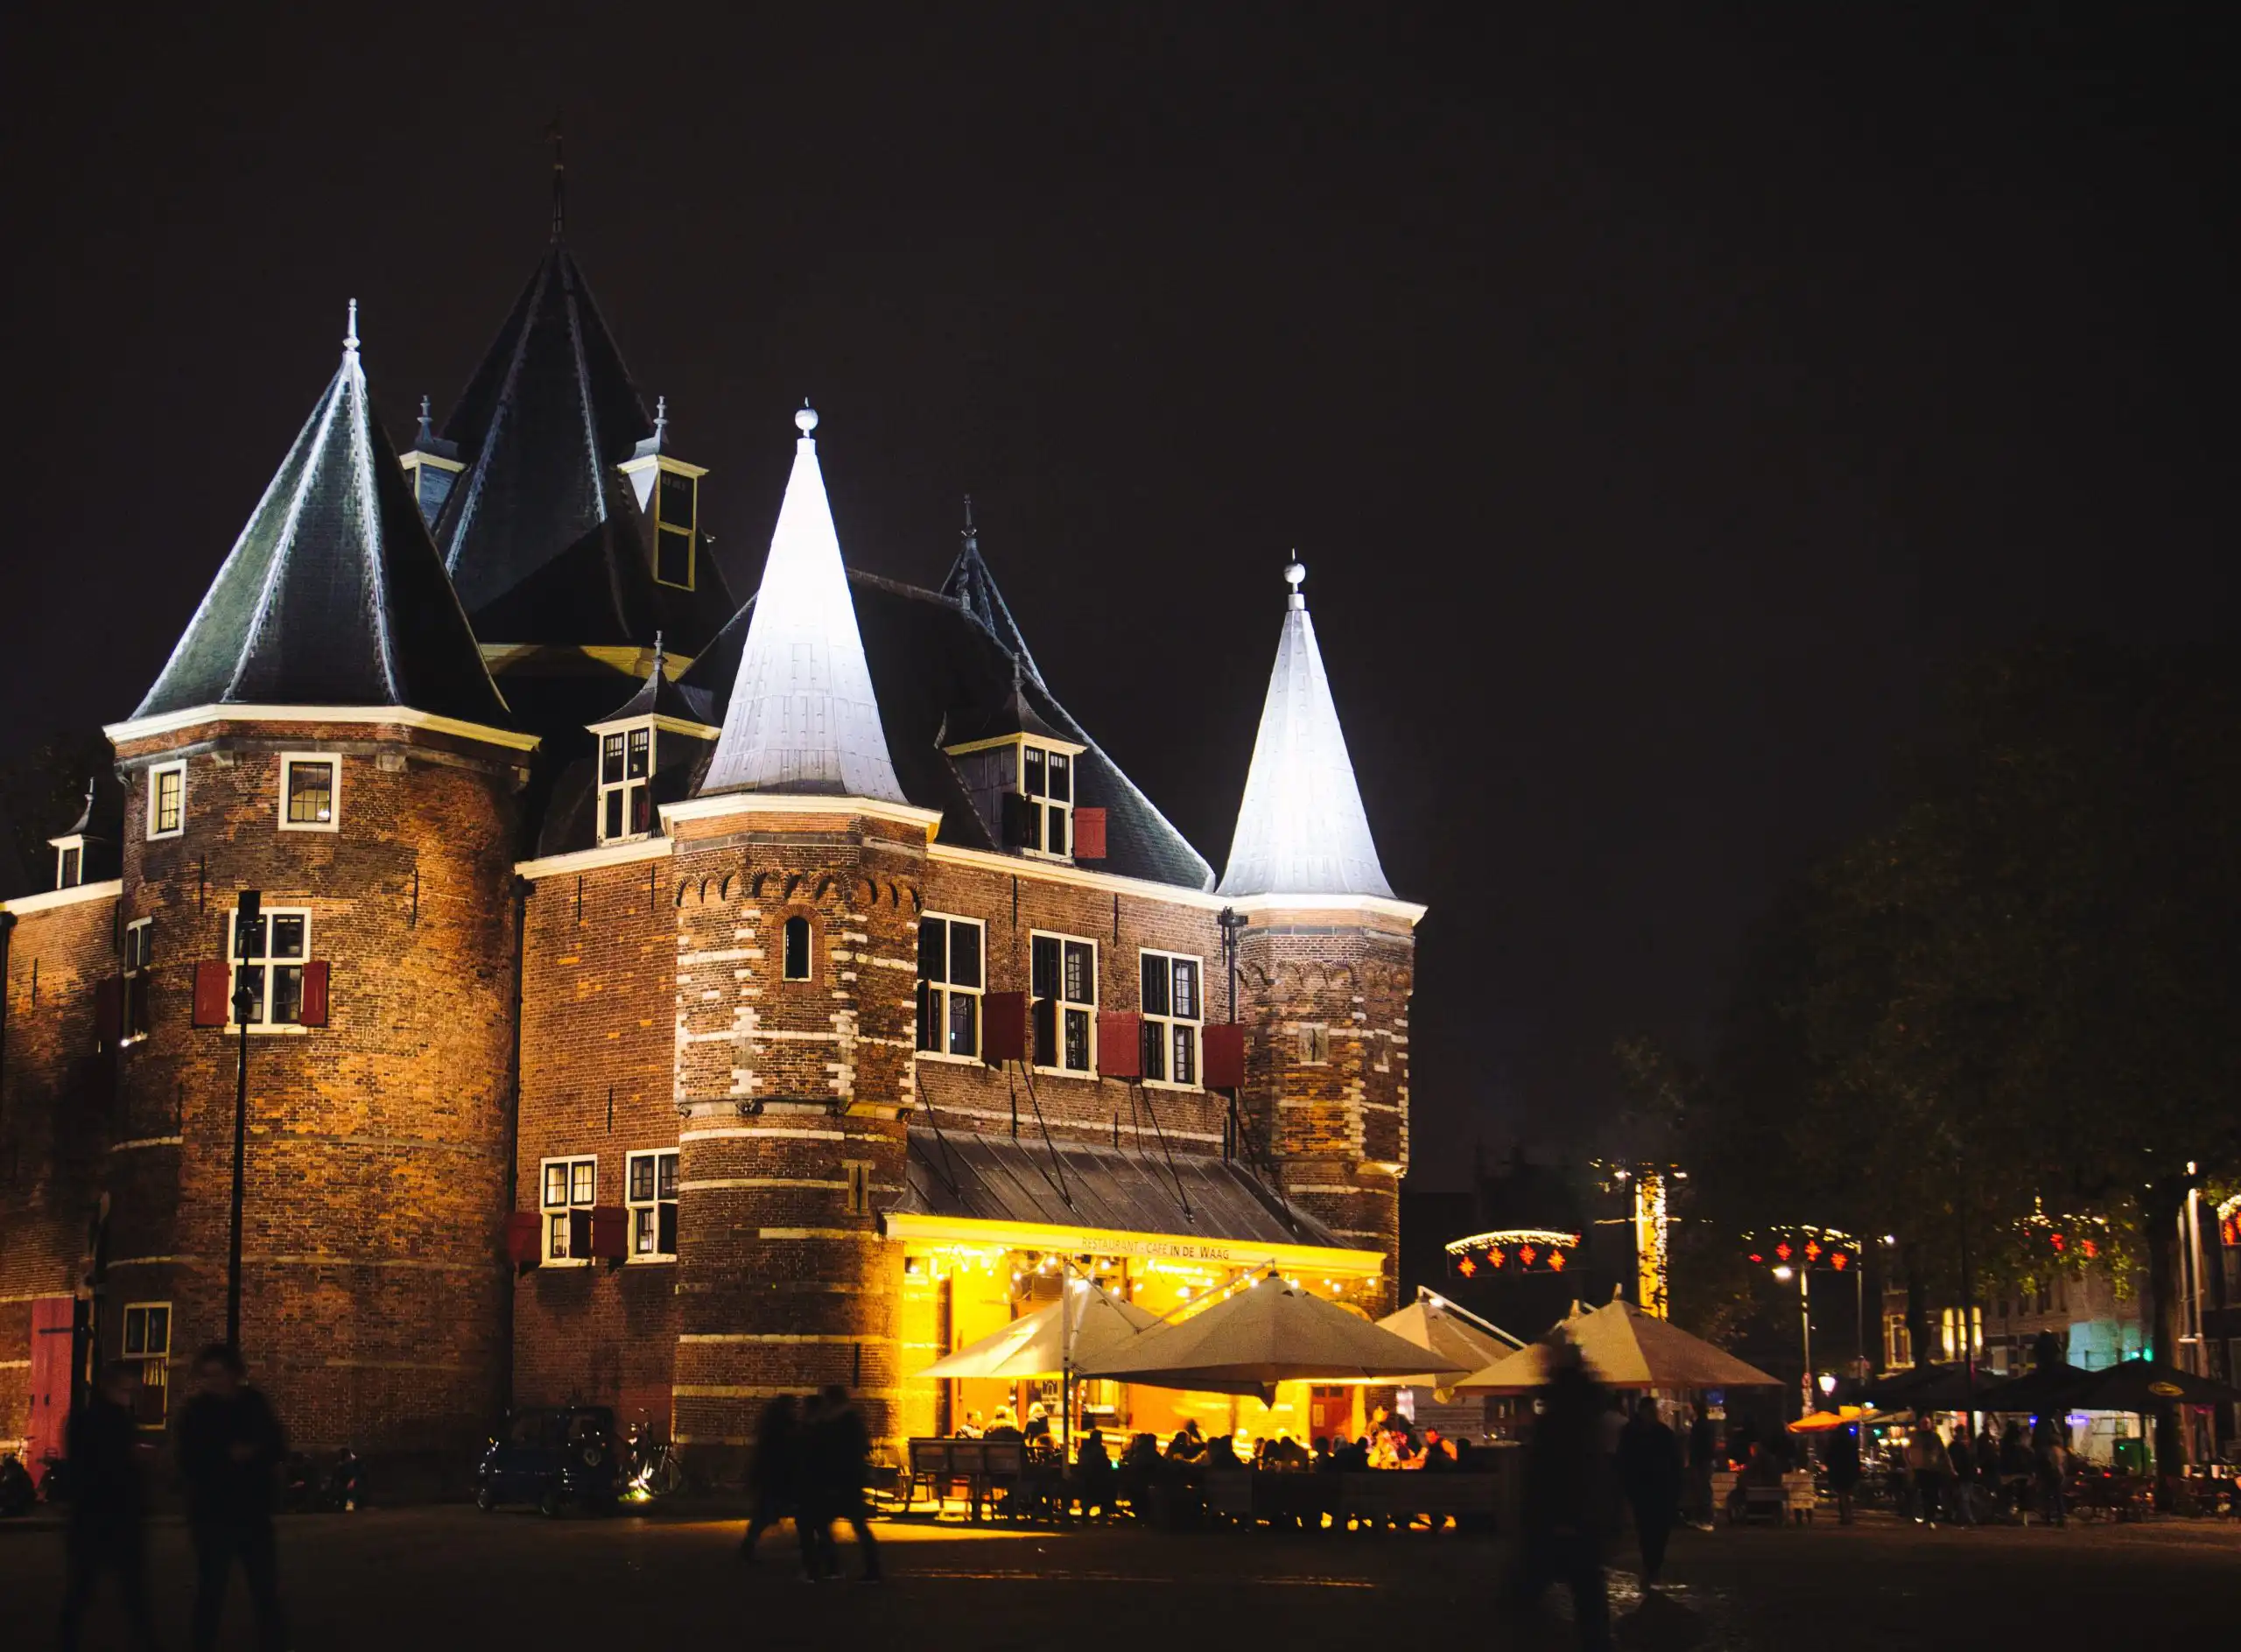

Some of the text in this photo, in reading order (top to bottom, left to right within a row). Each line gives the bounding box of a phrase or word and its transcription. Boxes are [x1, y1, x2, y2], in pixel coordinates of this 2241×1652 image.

[1082, 1236, 1138, 1252] RESTAURANT
[1170, 1246, 1180, 1256] IN
[1183, 1246, 1195, 1257] DE
[1199, 1246, 1229, 1260] WAAG
